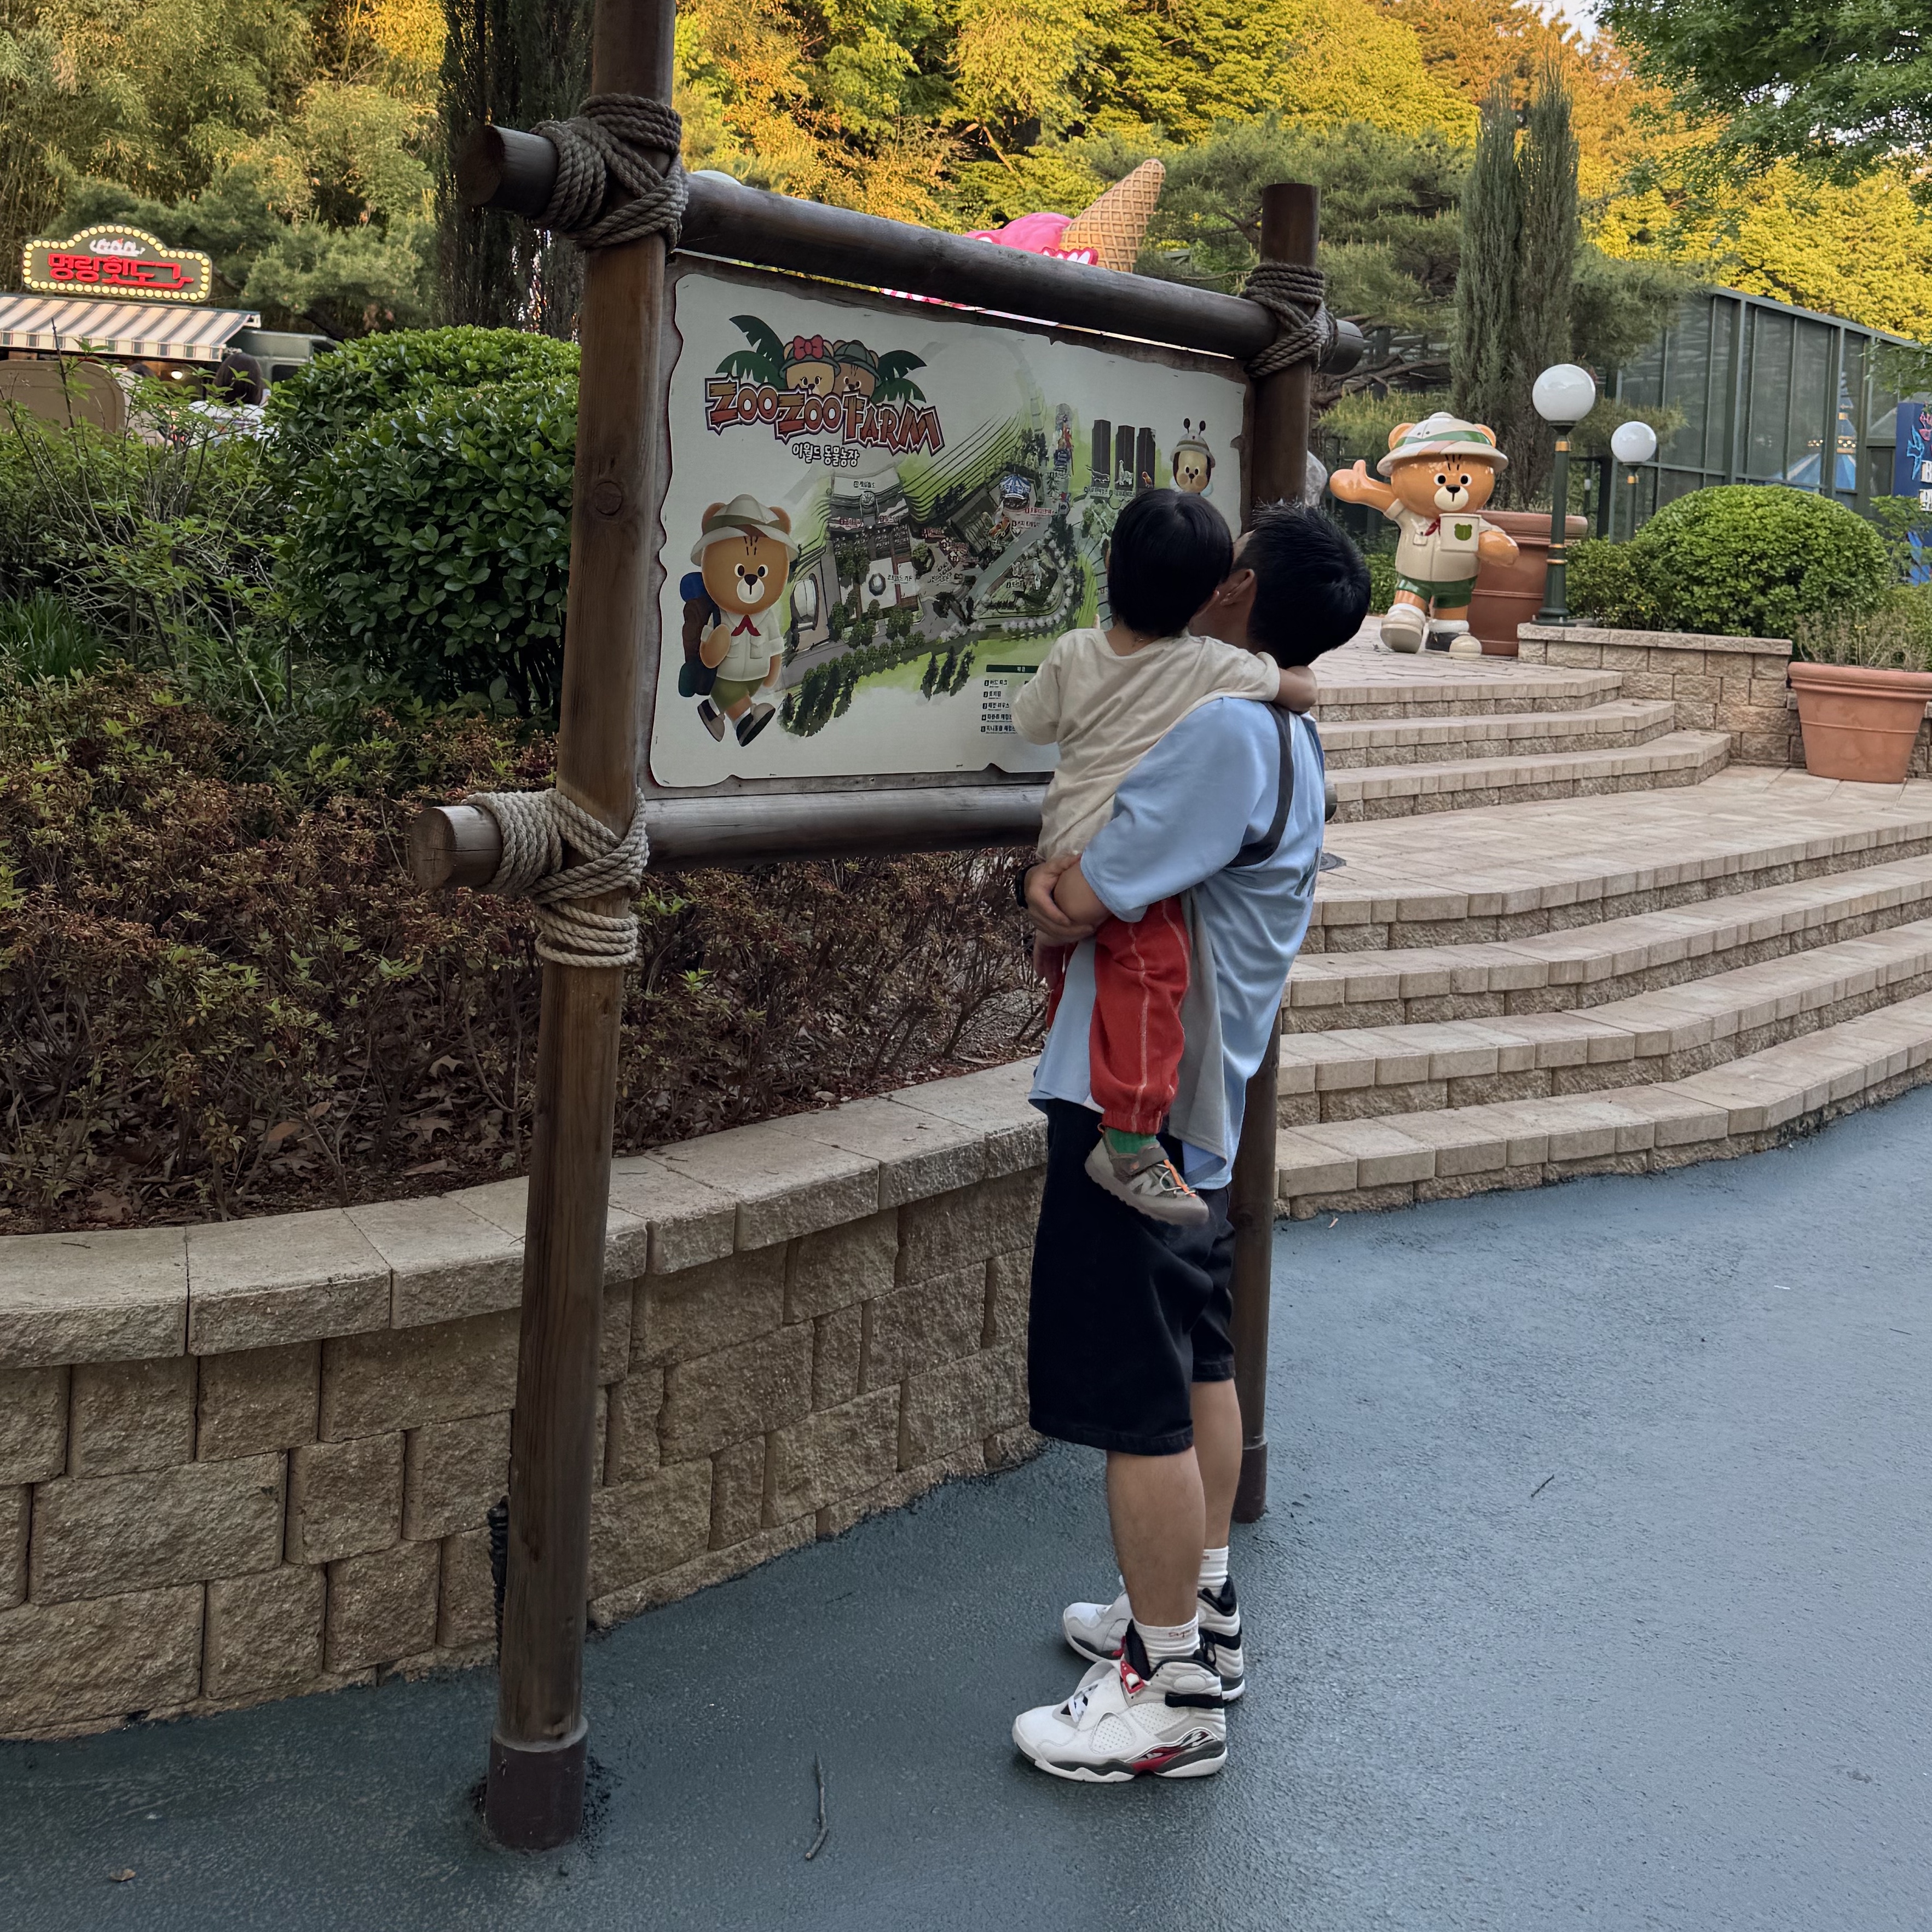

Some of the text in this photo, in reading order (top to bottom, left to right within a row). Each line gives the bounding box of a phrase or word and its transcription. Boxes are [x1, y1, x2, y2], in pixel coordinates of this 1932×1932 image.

[48, 253, 194, 289] 명랑핫도그
[793, 442, 860, 467] 이월드 동물농장
